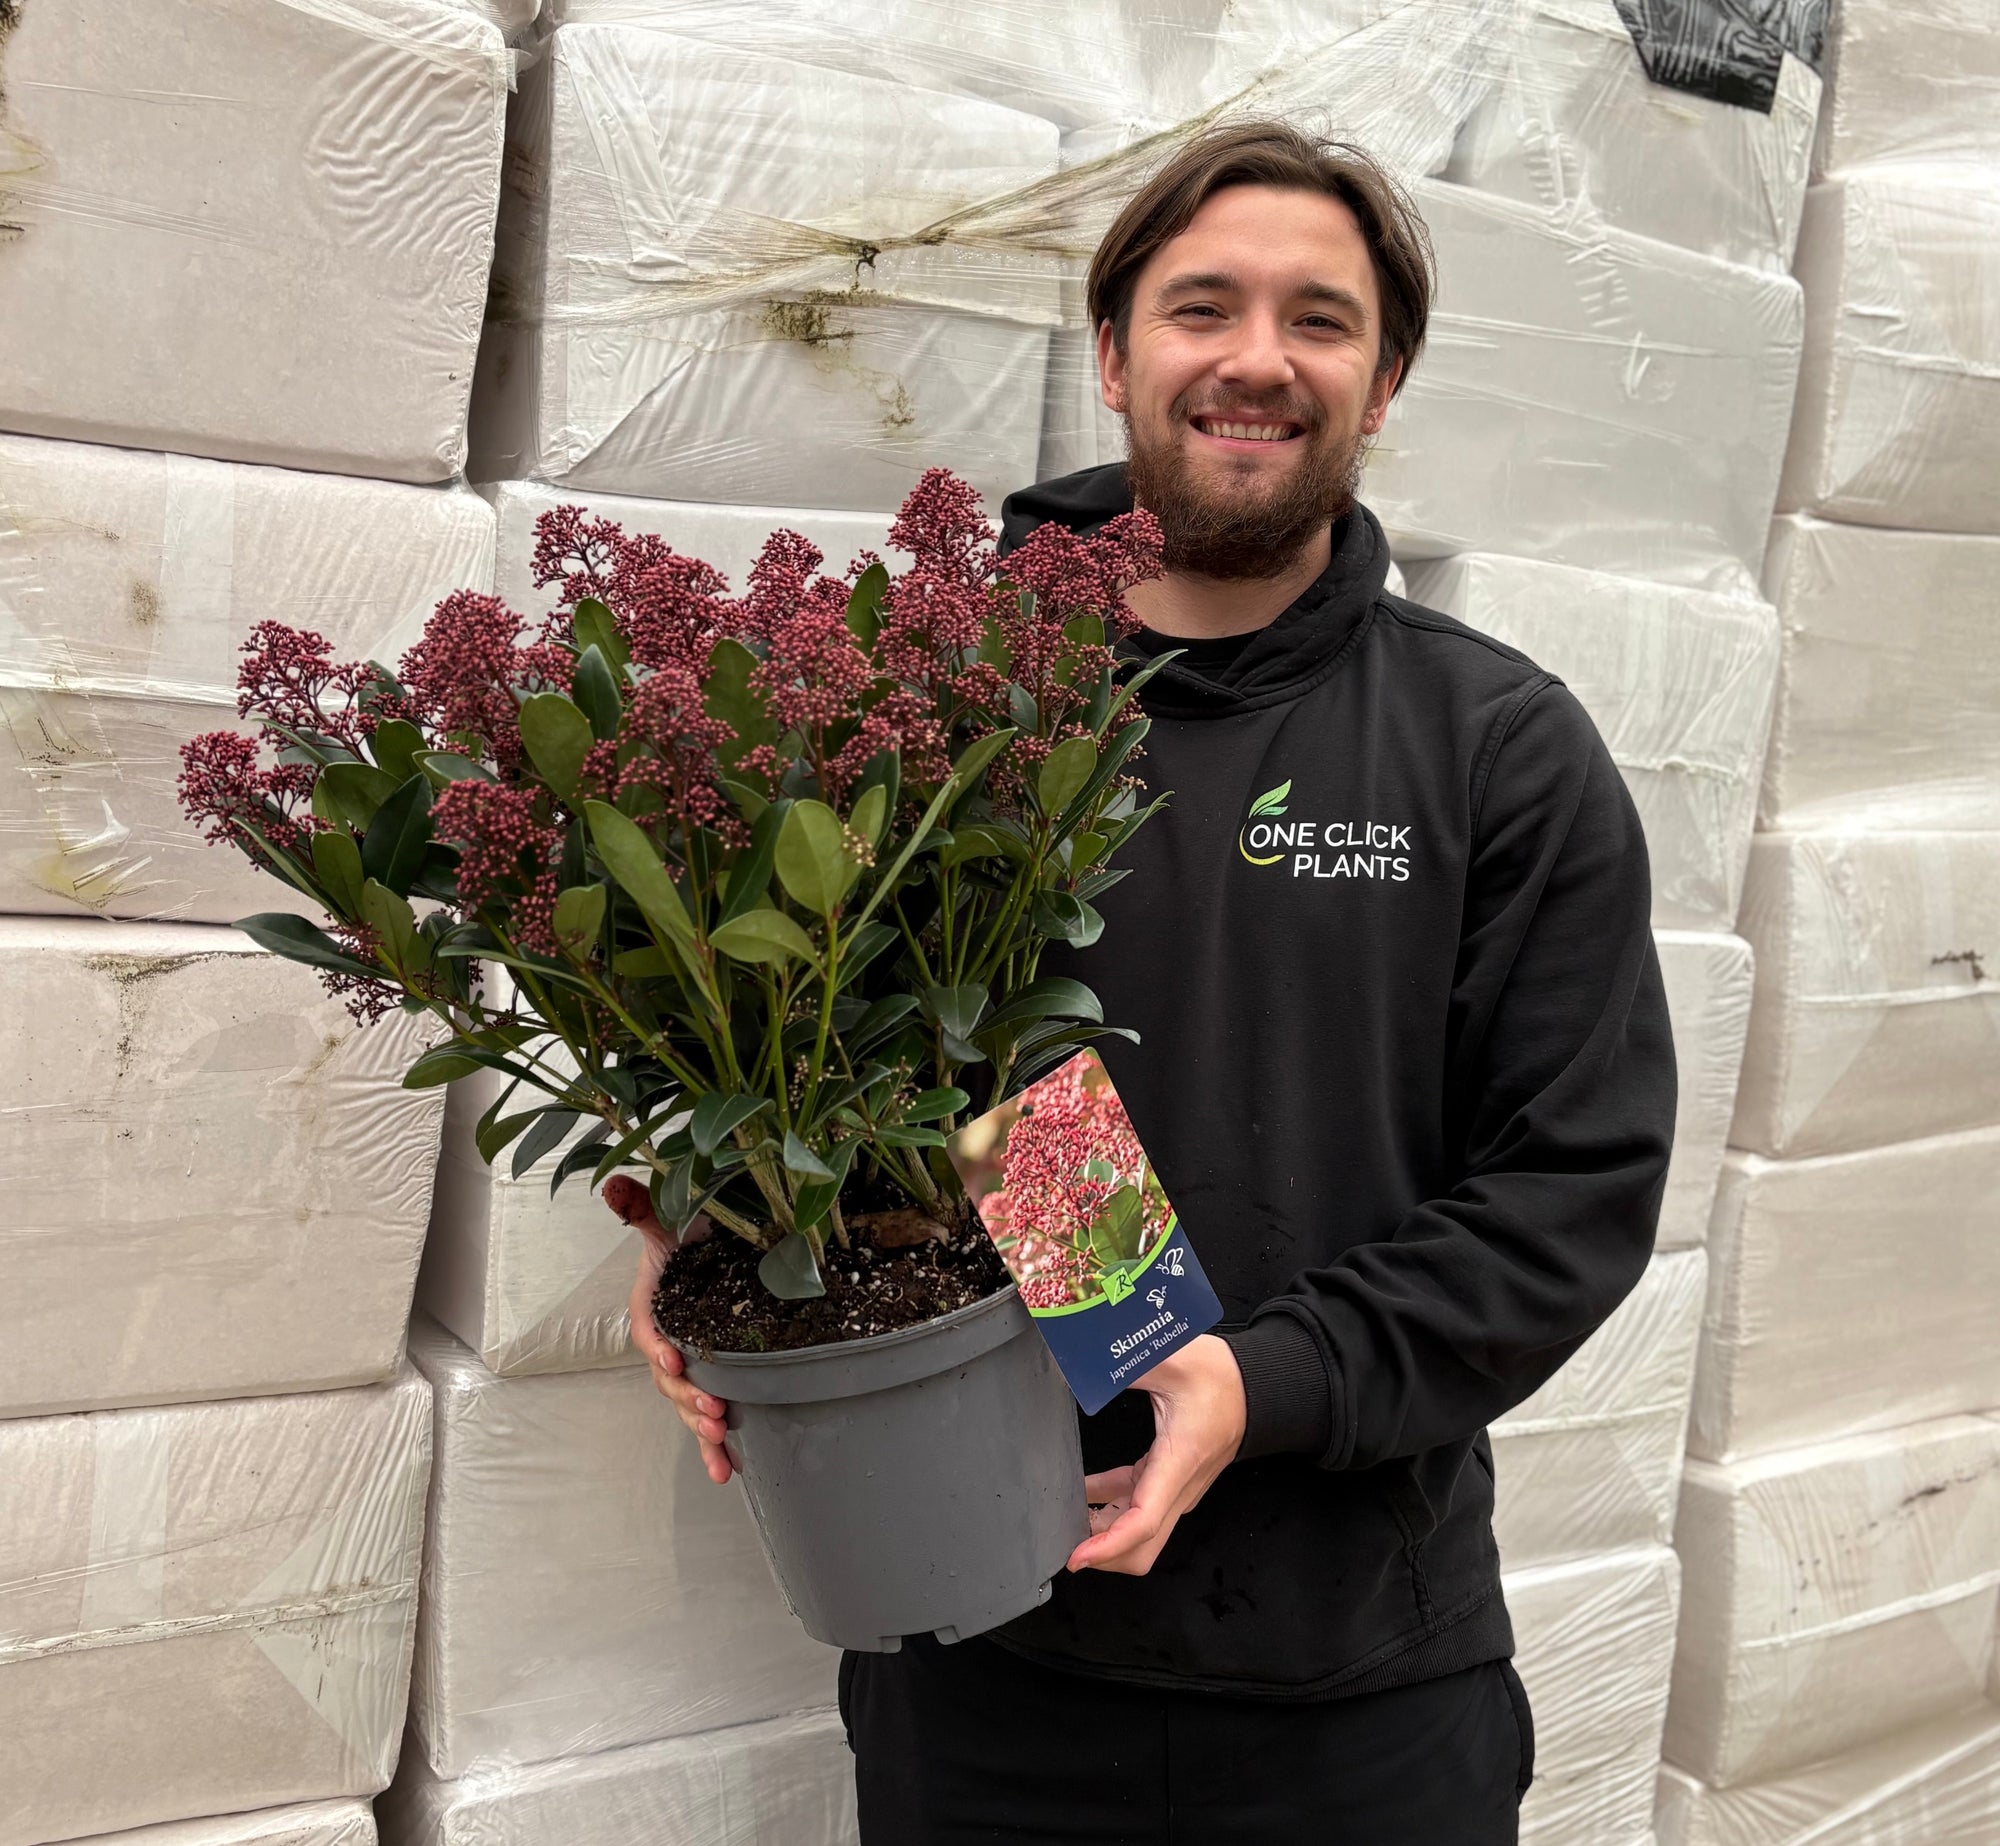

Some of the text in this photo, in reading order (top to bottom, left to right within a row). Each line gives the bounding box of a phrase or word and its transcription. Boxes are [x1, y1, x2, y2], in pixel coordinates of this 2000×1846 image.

[1249, 821, 1412, 851] ONE CLICK
[1293, 853, 1411, 882] PLANTS
[1109, 1317, 1190, 1384] japonica 'Rubella'
[1110, 1309, 1175, 1360] Skimmia
